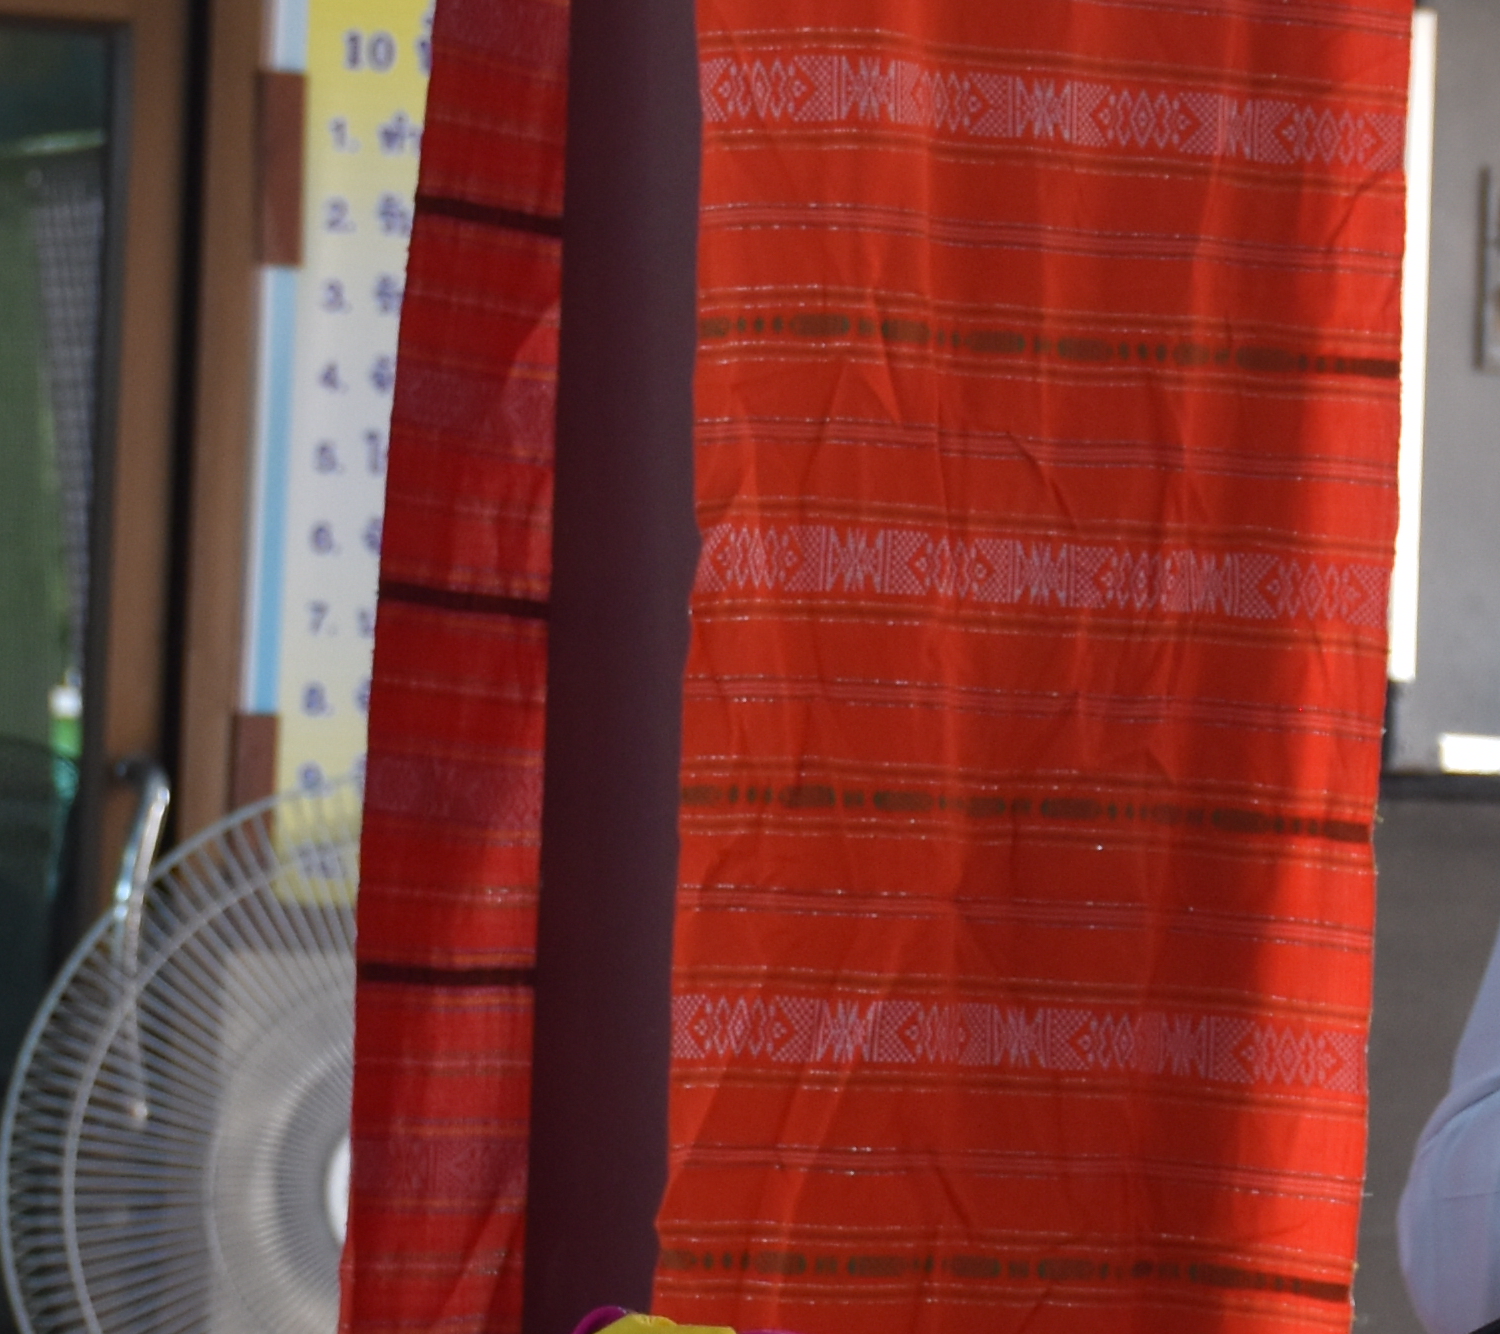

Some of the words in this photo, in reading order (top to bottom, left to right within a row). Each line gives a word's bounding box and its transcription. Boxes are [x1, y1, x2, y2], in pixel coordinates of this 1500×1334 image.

[342, 27, 398, 75] 10
[329, 115, 361, 155] 1.
[324, 195, 356, 237] 2.
